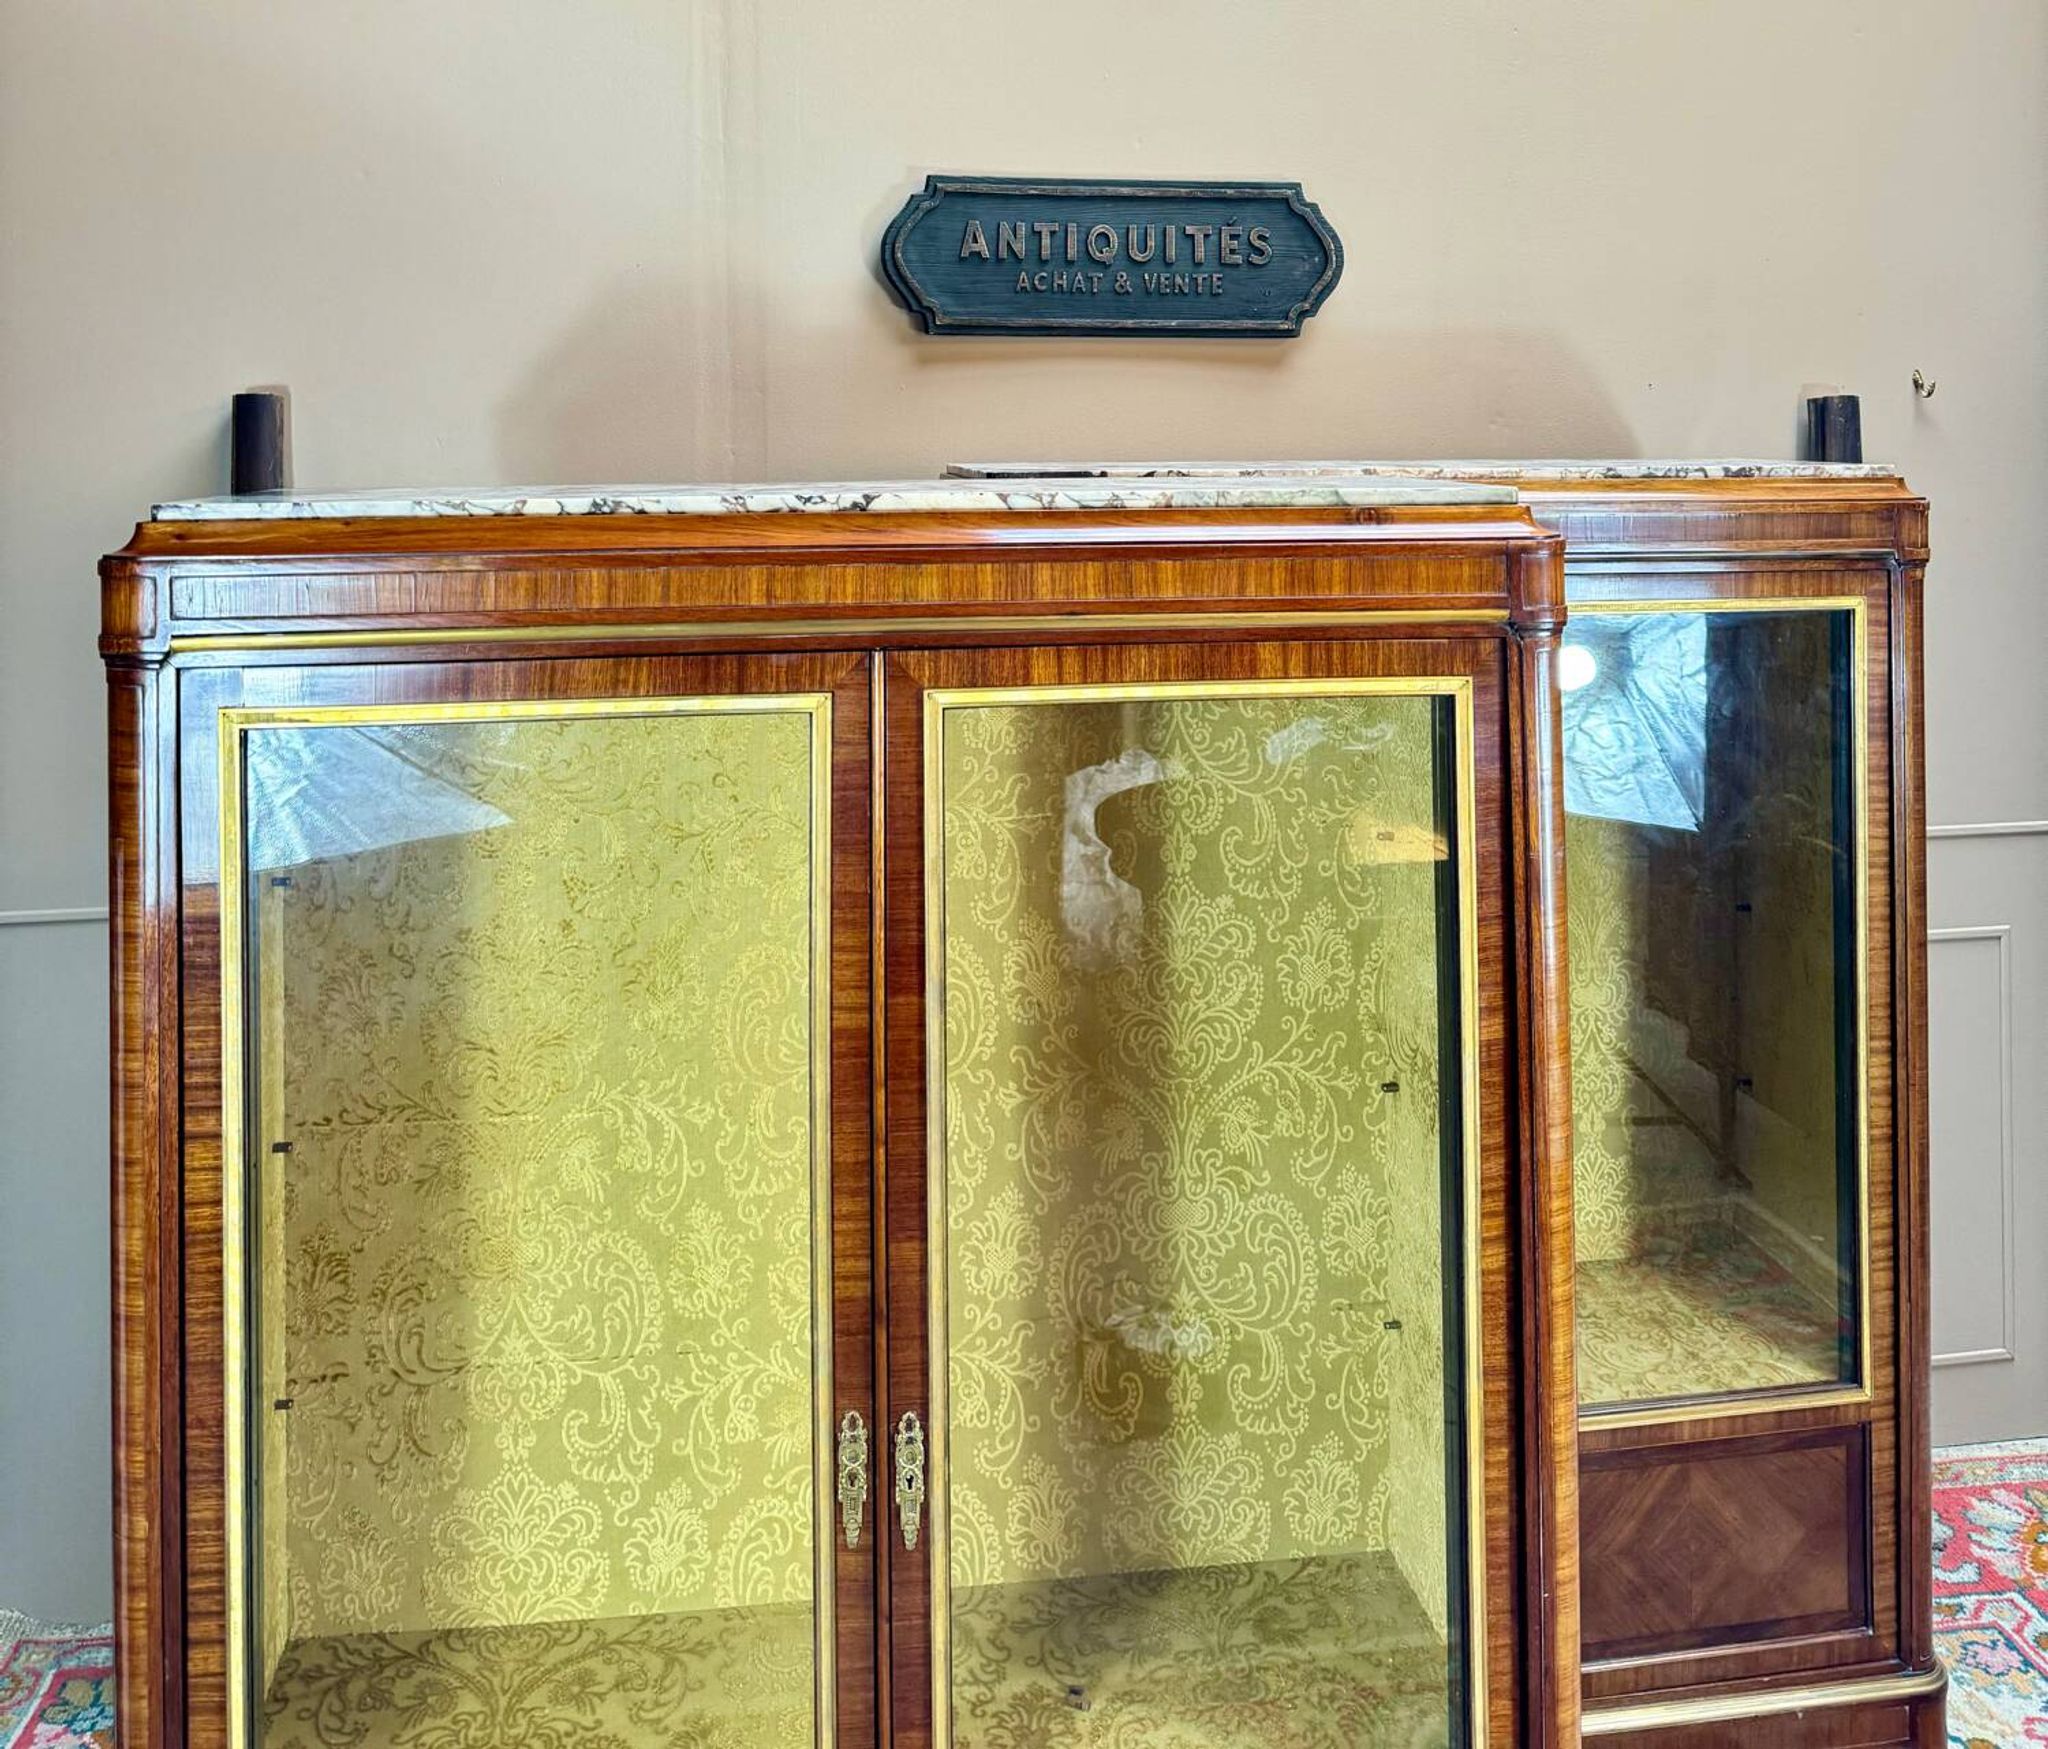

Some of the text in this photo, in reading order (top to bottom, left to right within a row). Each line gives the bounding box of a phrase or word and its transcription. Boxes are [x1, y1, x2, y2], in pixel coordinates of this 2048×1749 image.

[960, 216, 1274, 266] ANTIQUITÉS
[1015, 271, 1225, 296] ACHAT & VENTE
